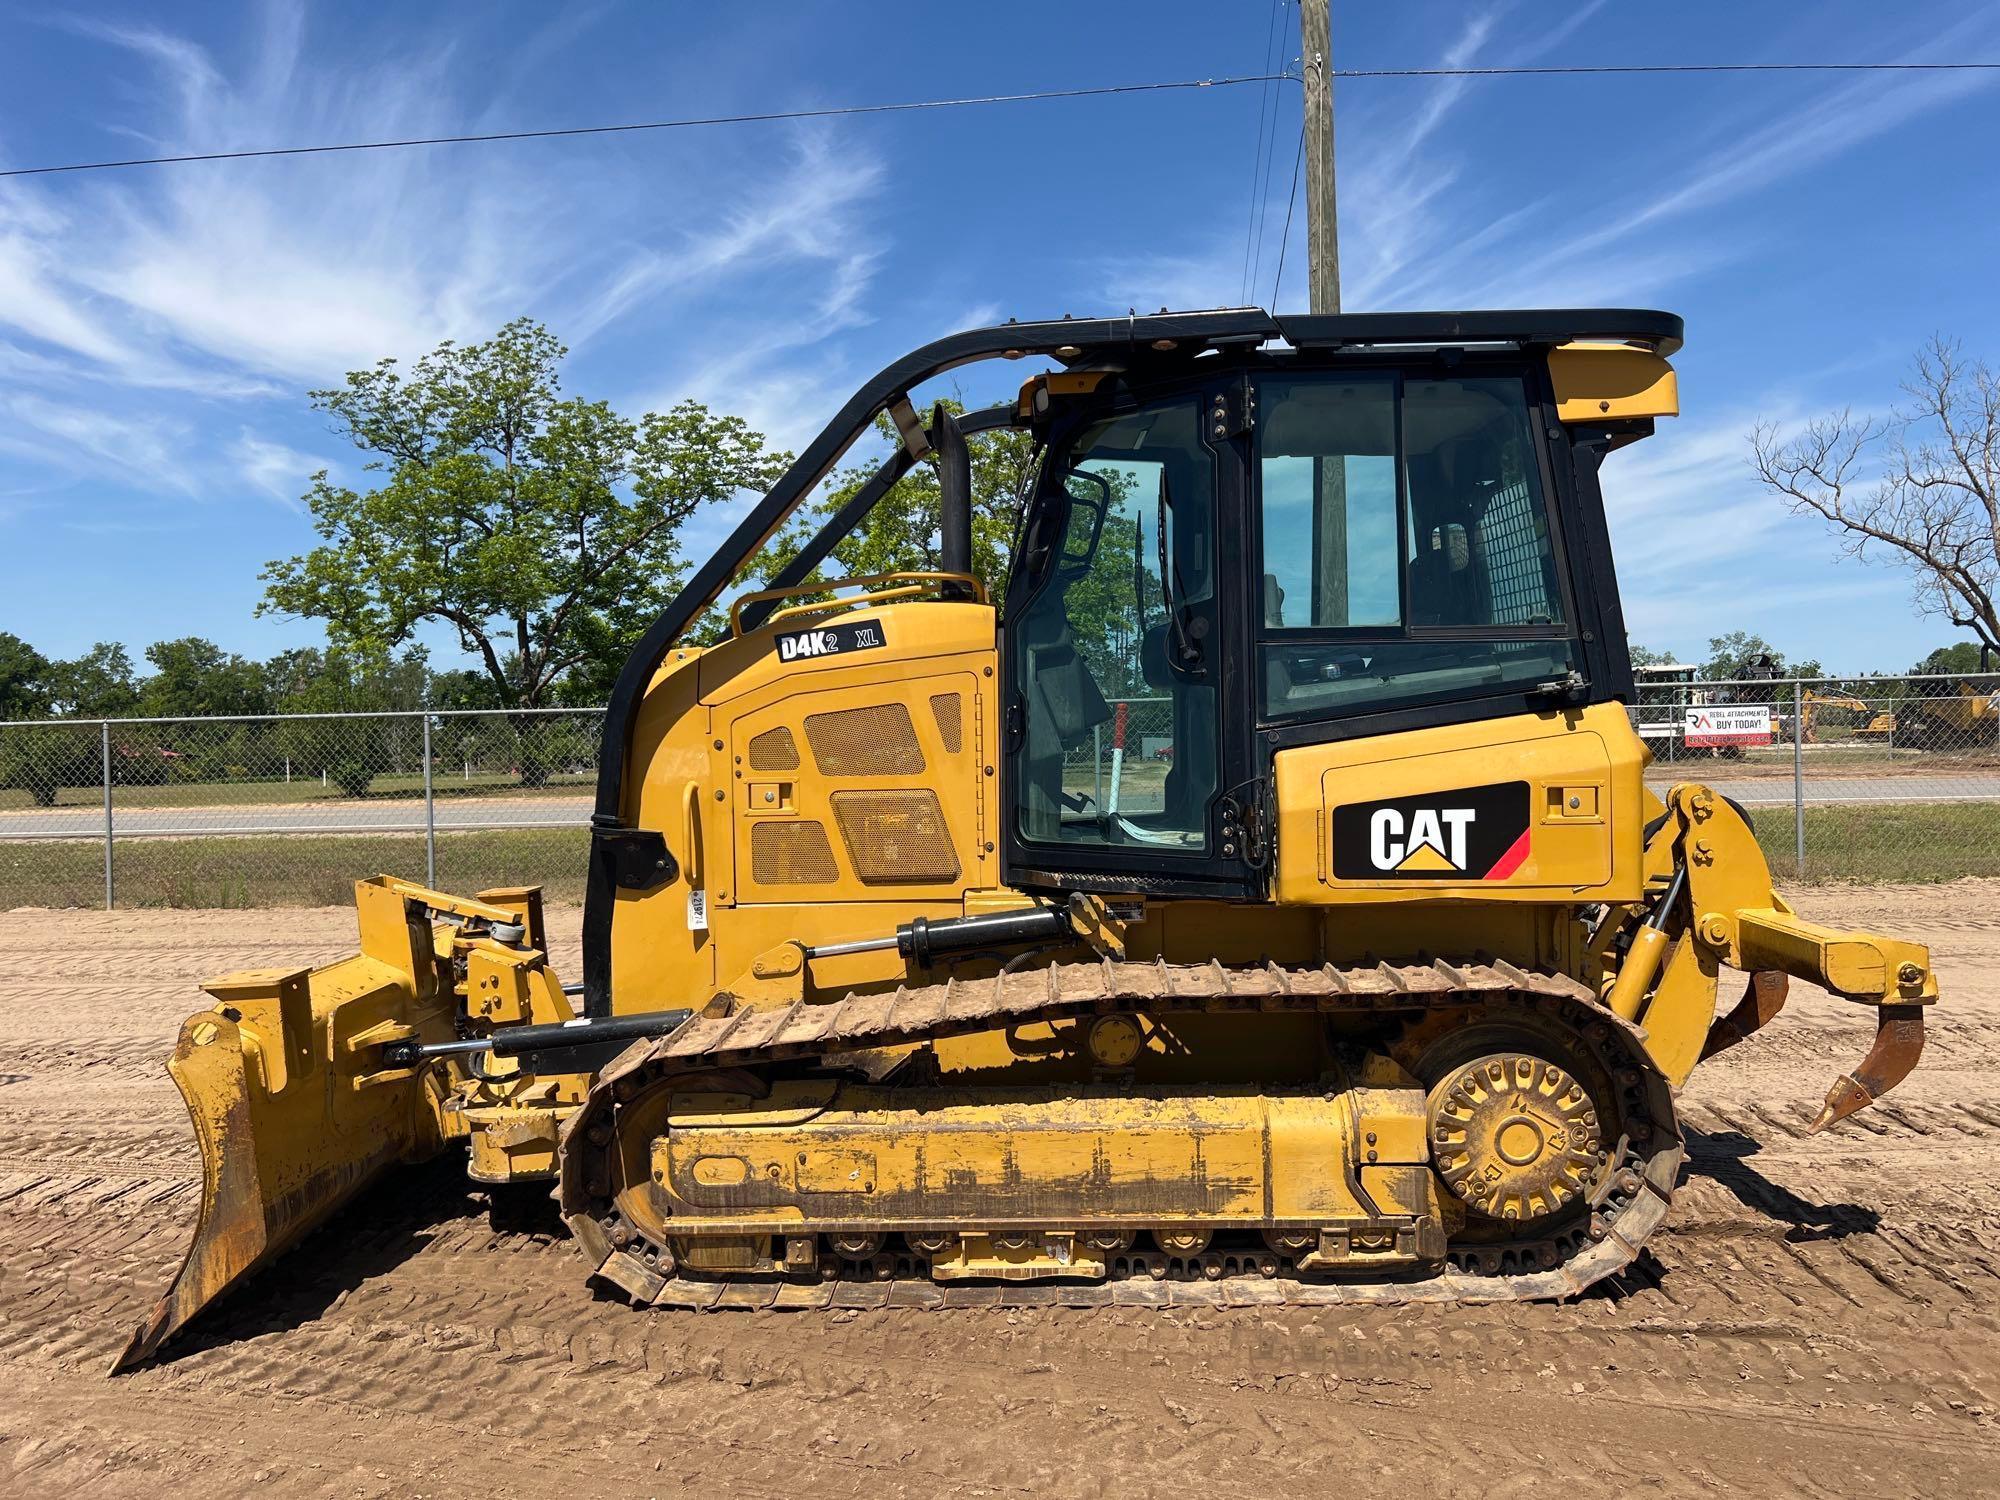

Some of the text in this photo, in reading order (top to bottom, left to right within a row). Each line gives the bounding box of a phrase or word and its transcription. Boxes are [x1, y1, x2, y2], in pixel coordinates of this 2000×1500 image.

[781, 628, 880, 660] D4K2 XL
[1727, 710, 1768, 718] ATTACHMENTS
[1716, 720, 1761, 729] BUY TODAY!
[1370, 808, 1476, 871] CAT
